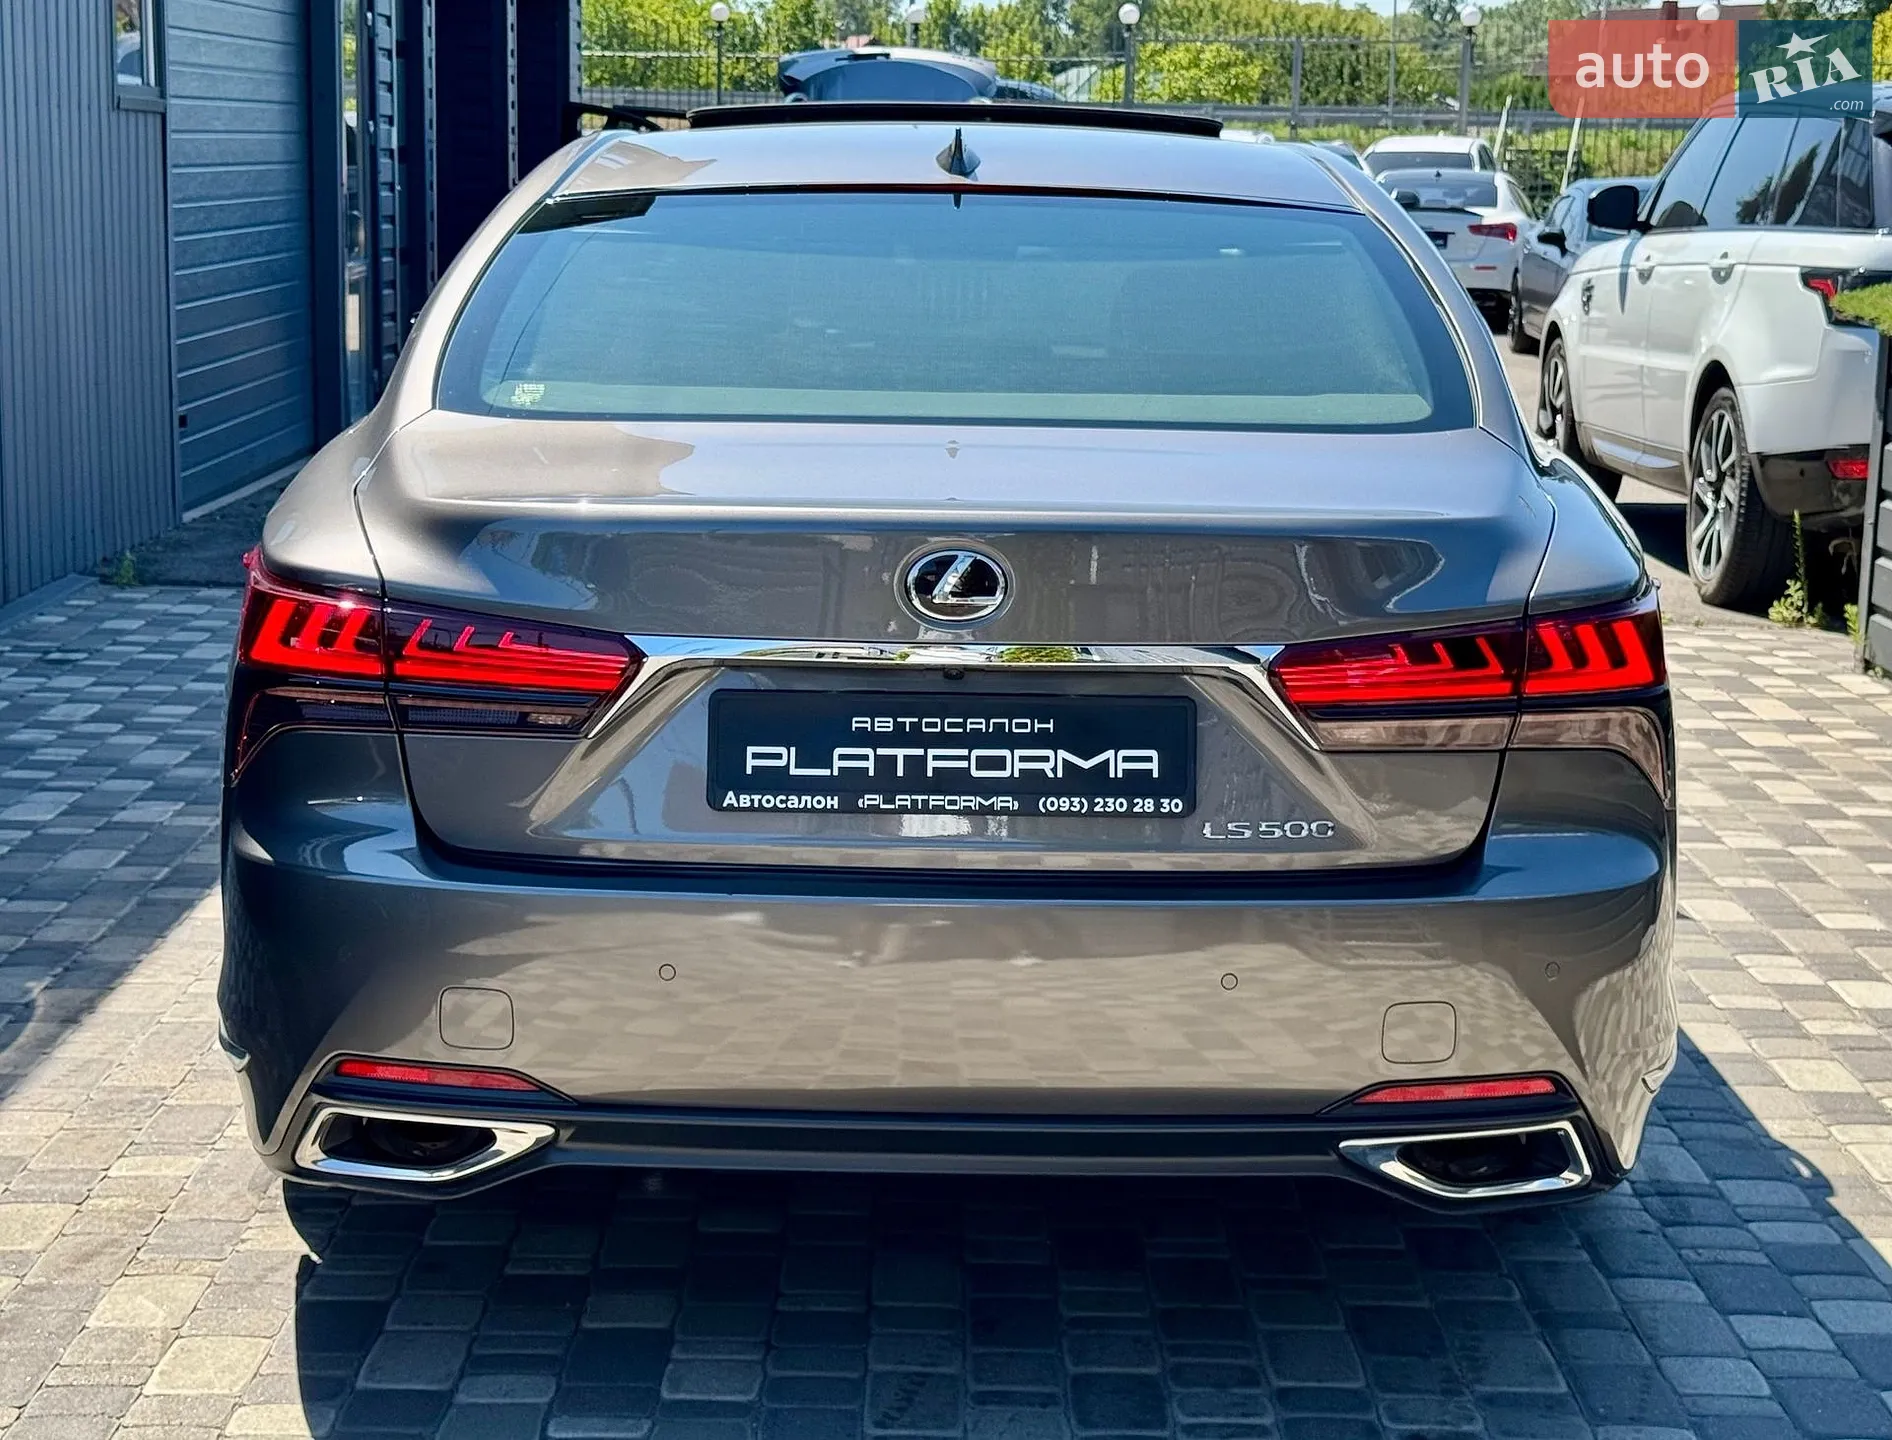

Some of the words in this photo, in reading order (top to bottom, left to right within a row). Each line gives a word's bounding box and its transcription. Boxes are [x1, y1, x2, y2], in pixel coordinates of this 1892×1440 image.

[852, 717, 1054, 733] АВТОСАЛОН
[746, 746, 1159, 779] PLATFORMA
[722, 790, 839, 810] Автосалон
[1038, 796, 1088, 814] (093)
[1093, 797, 1128, 813] 230
[1132, 798, 1155, 813] 28
[1159, 798, 1184, 814] 30
[1202, 821, 1253, 839] LS
[1258, 820, 1336, 839] 500
